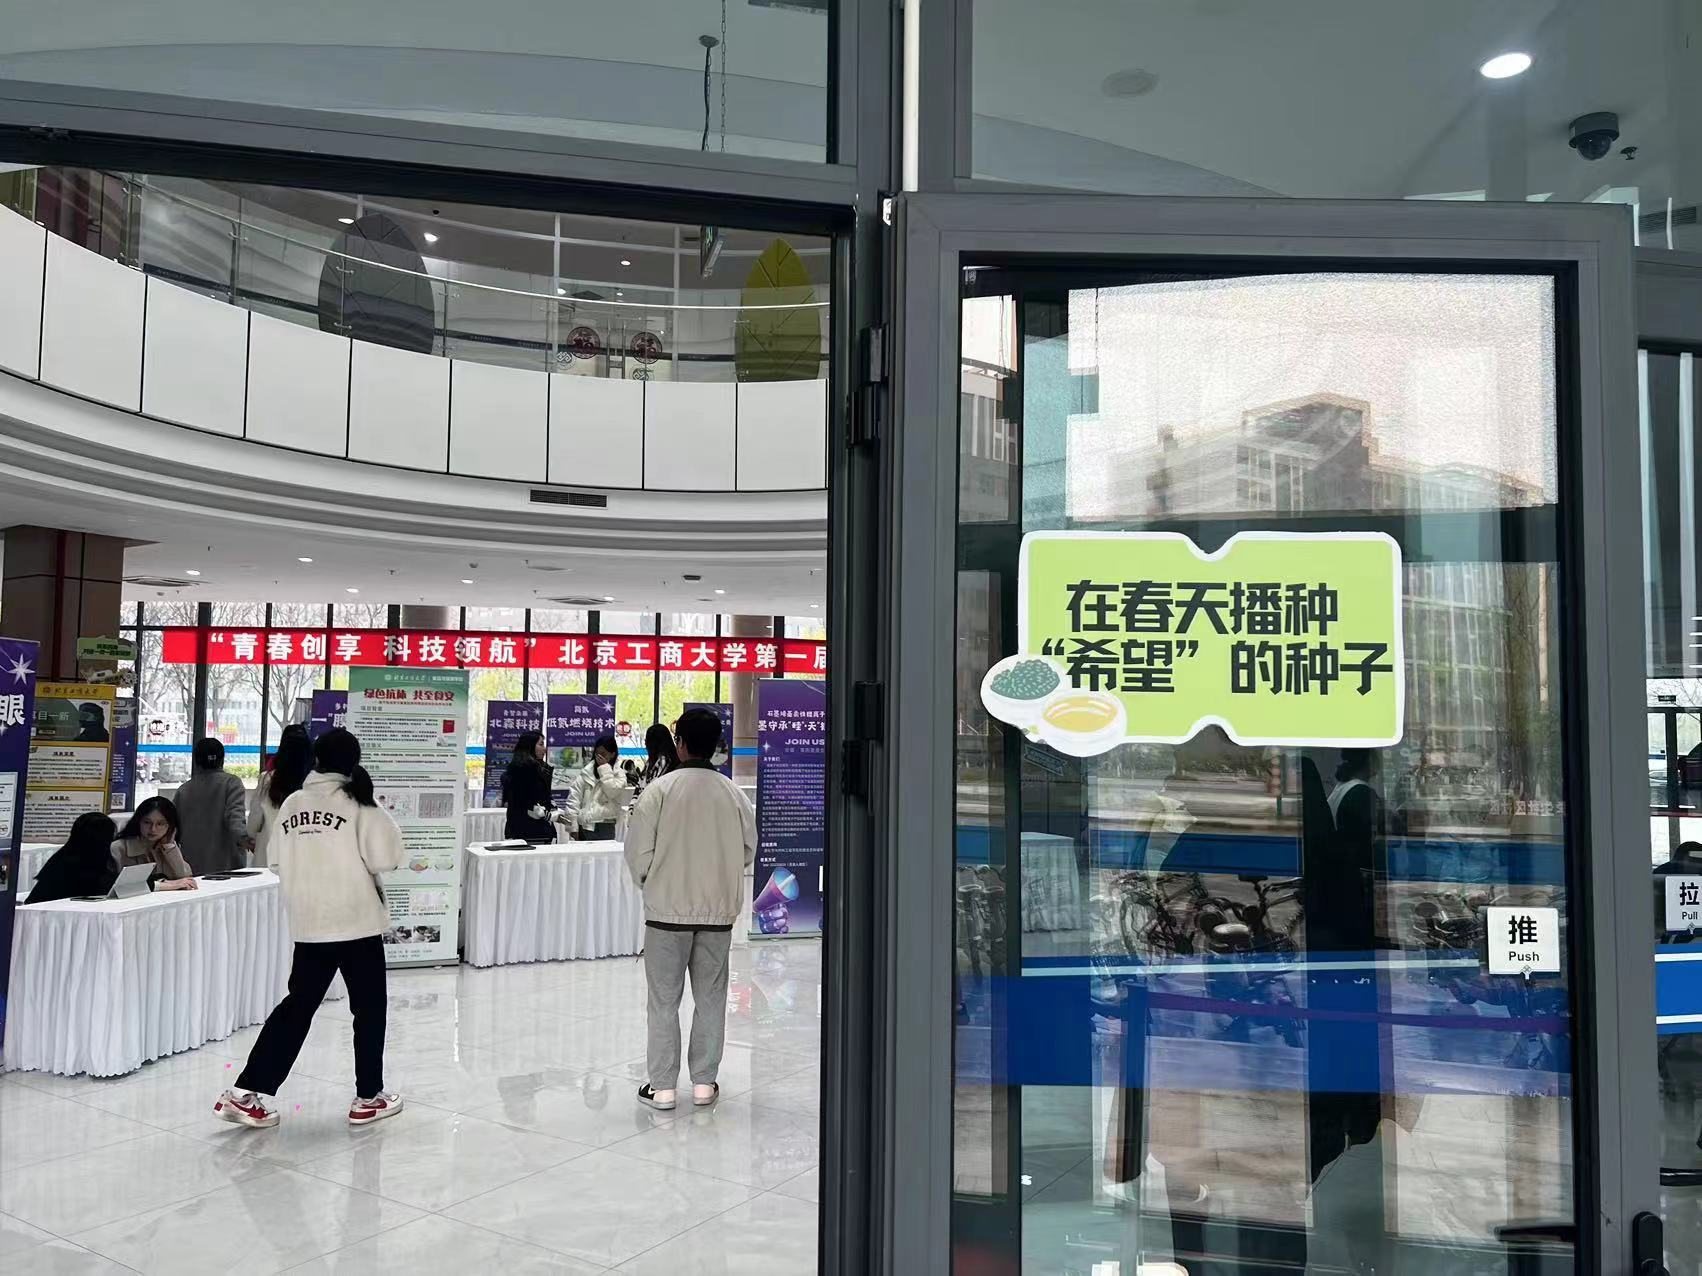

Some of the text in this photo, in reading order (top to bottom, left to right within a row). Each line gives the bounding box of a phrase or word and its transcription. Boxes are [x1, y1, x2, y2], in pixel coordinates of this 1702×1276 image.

[1066, 579, 1339, 637] 在春天播种
[210, 632, 362, 662] “青春创享
[1042, 637, 1394, 696] “希望” 的种子
[784, 738, 826, 746] JOIN US
[281, 810, 347, 835] FOREST
[1679, 881, 1700, 907] 拉
[1681, 911, 1698, 921] Pull
[1508, 915, 1538, 945] 推
[1508, 951, 1540, 962] Push
